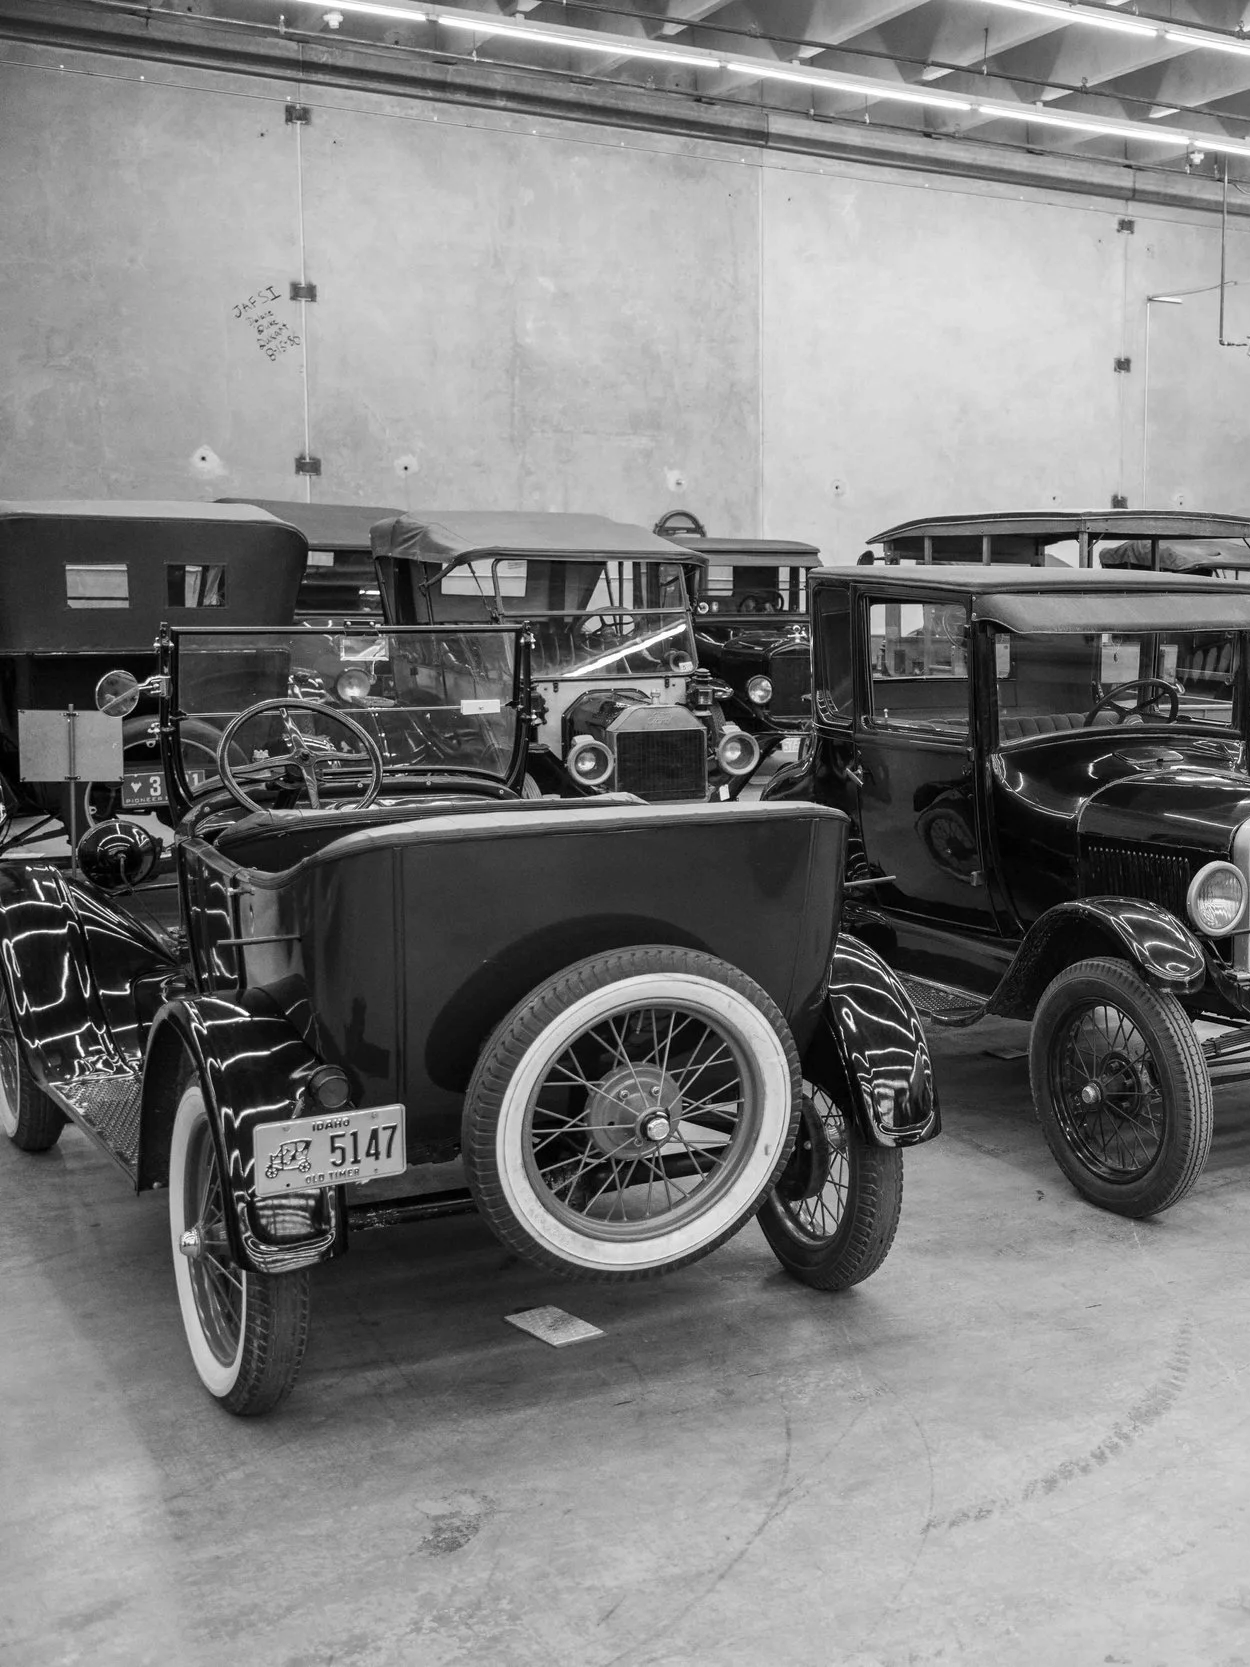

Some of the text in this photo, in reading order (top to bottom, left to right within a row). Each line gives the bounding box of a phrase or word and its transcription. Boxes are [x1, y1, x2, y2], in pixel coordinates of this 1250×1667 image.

[125, 796, 163, 804] PIONEER
[312, 1116, 350, 1132] IDAHO
[329, 1122, 398, 1167] 5147
[305, 1168, 360, 1184] OLD TIMER
